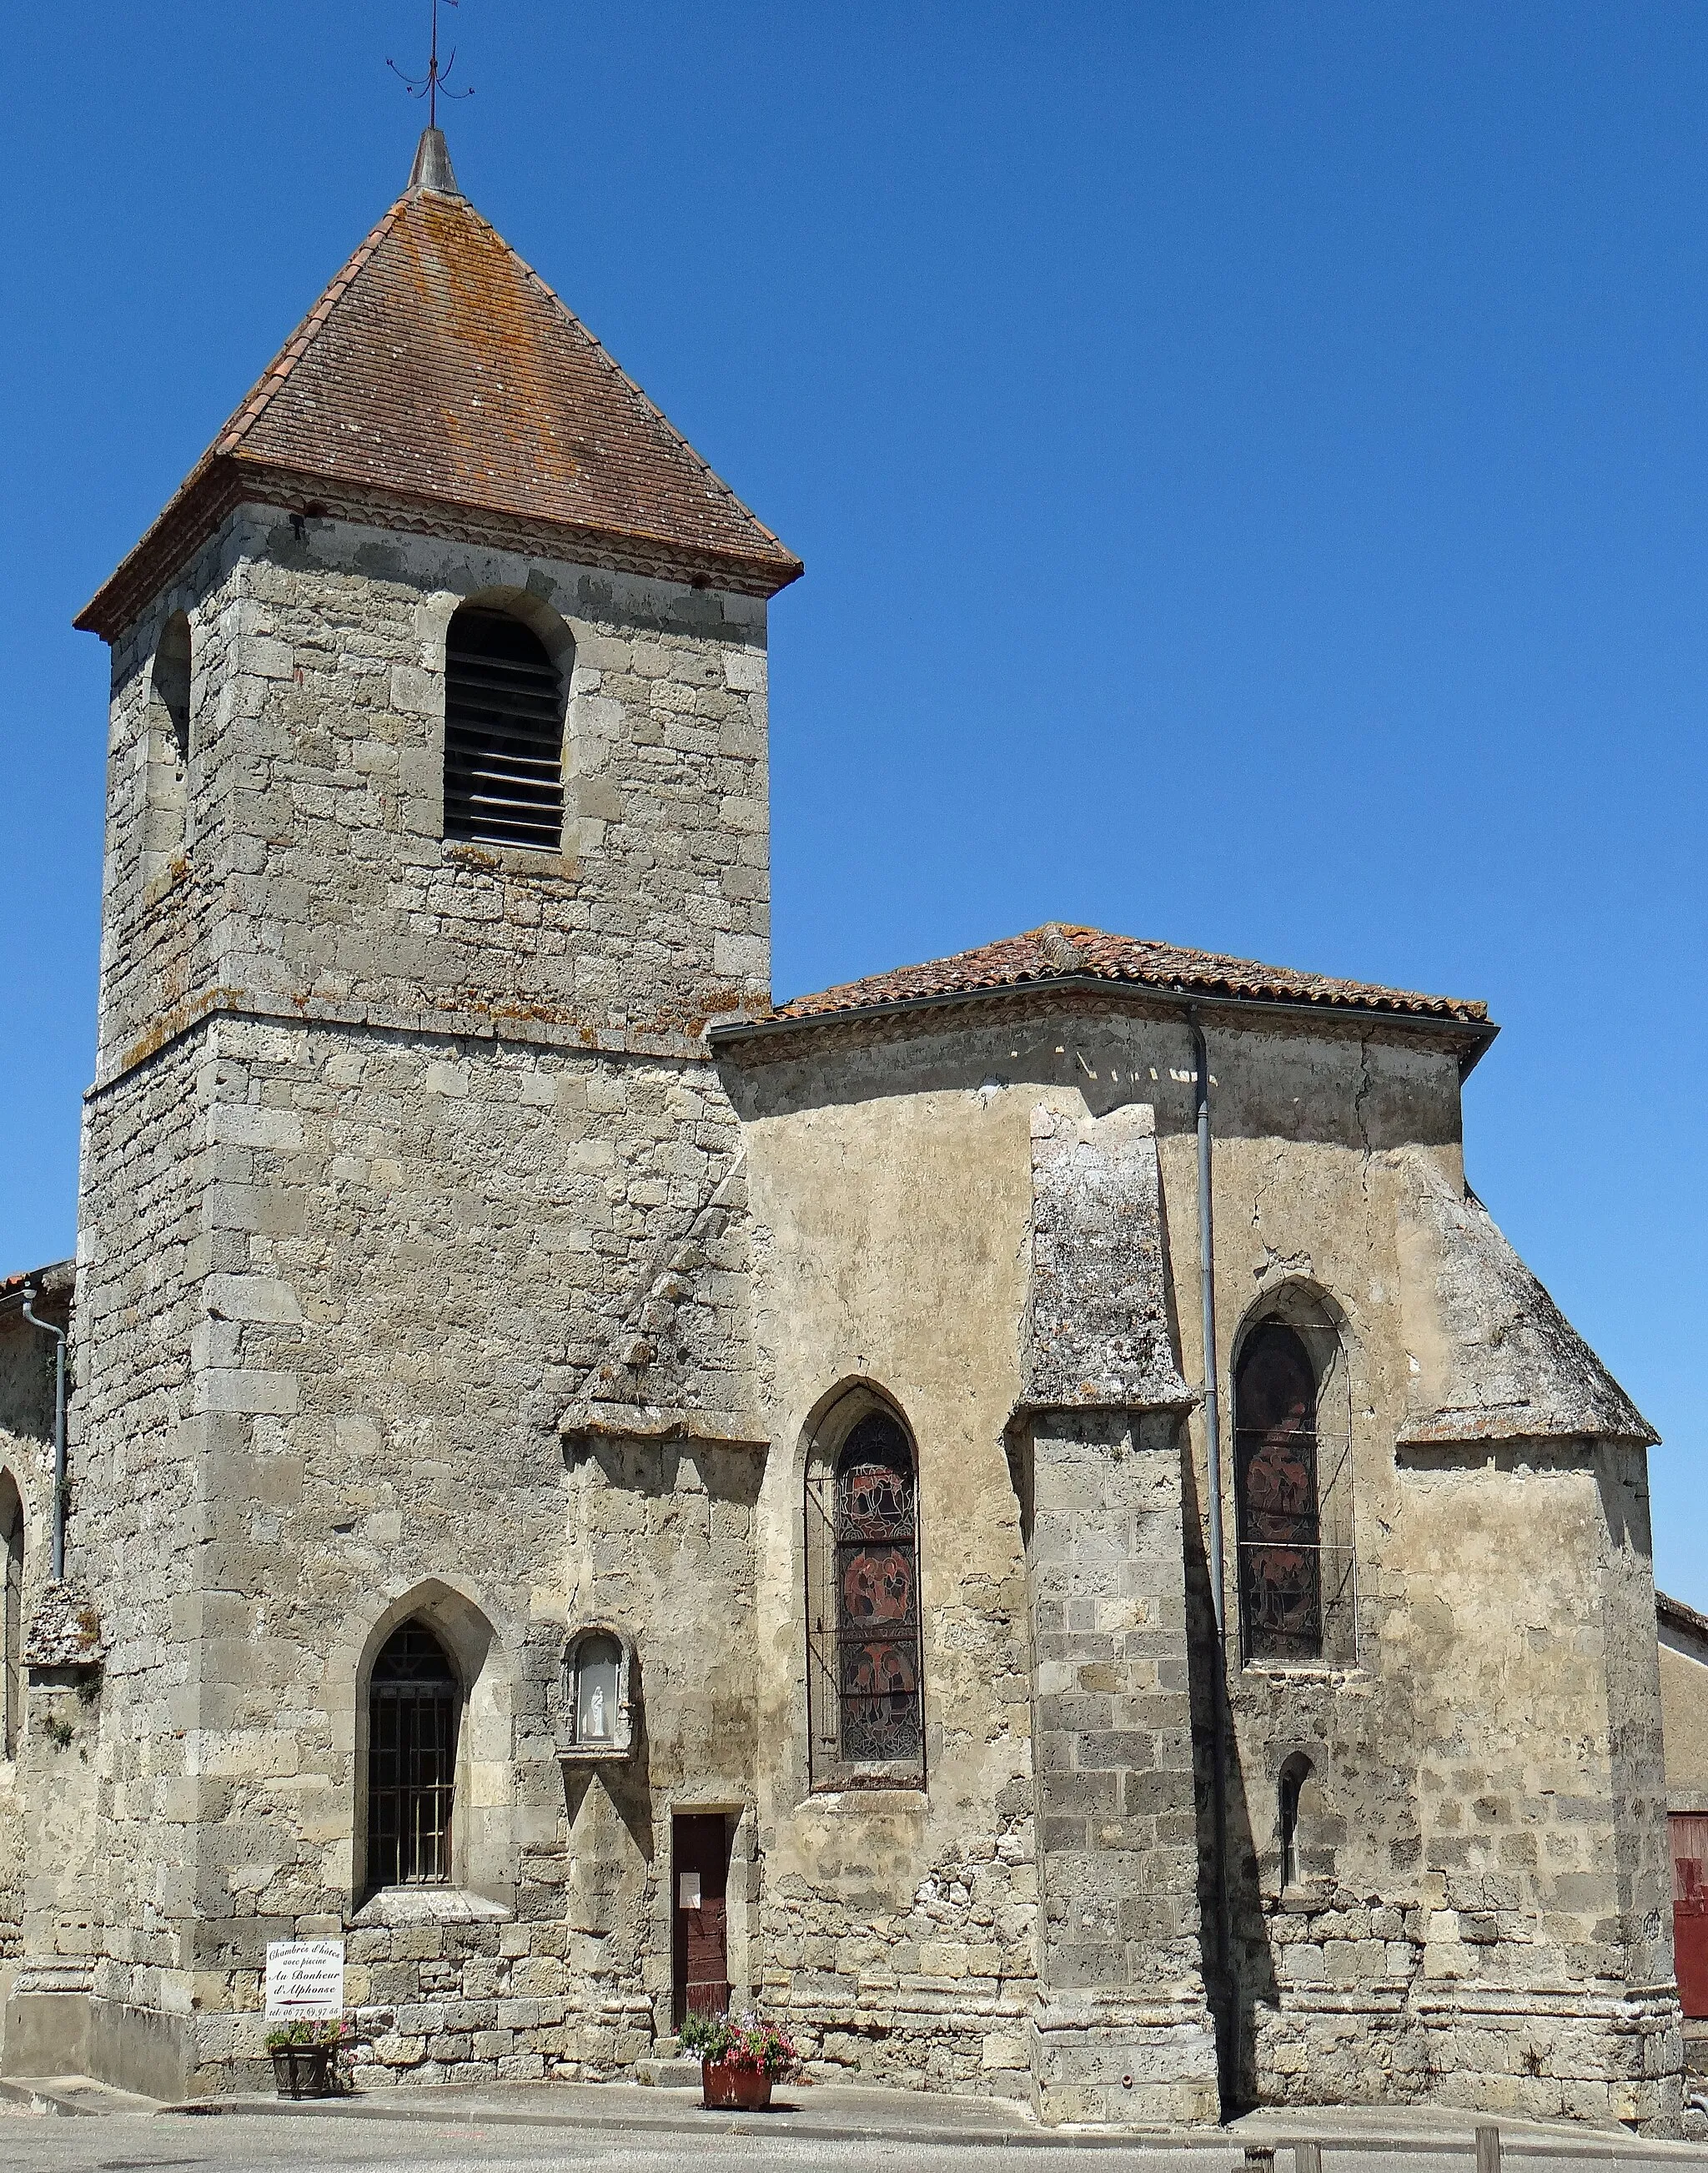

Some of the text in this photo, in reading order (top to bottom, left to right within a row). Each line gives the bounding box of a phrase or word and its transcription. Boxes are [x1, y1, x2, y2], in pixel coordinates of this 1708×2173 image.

[269, 1944, 340, 1960] Chambres d'hôtes
[300, 1957, 327, 1969] piscine
[269, 1969, 340, 1980] Au Bonheur
[274, 1984, 336, 1998] d'Alphonse
